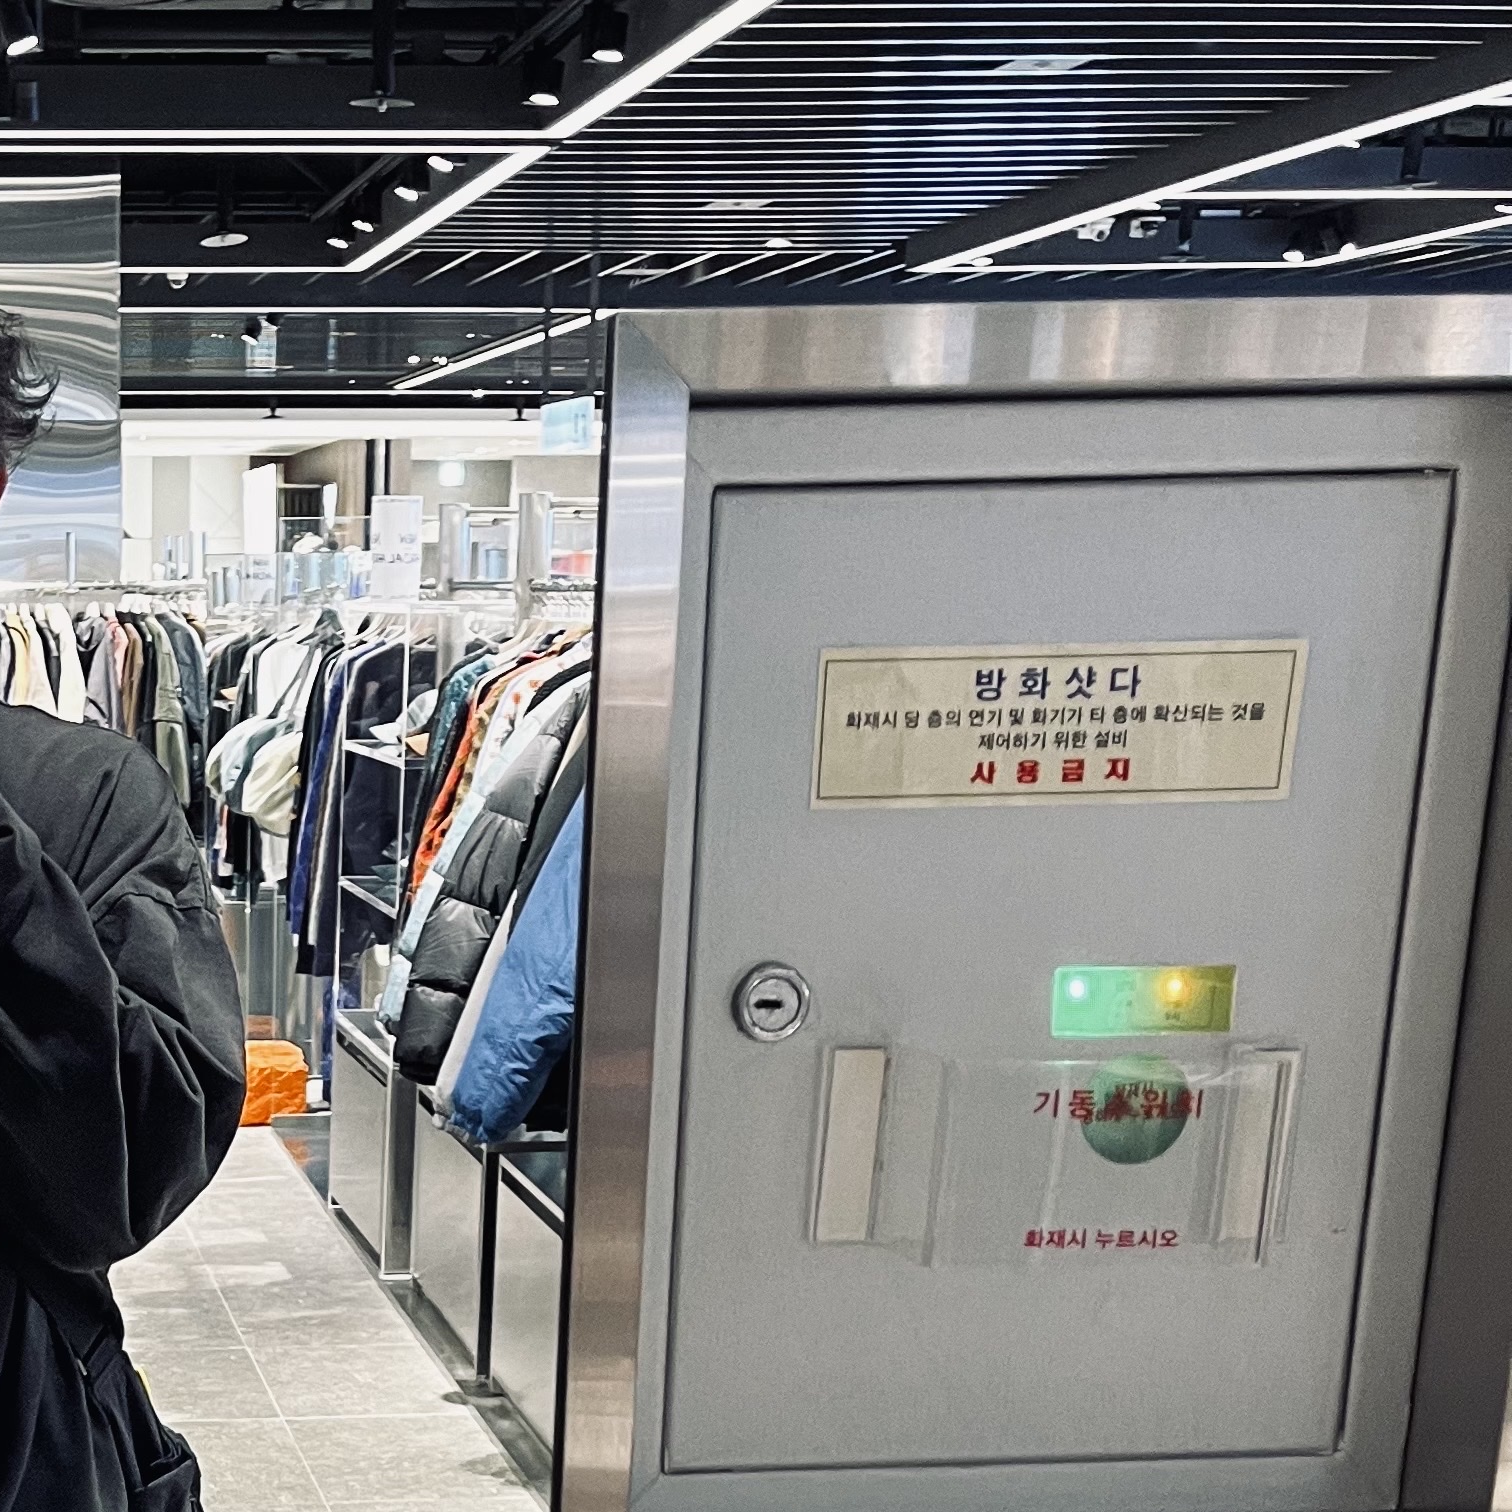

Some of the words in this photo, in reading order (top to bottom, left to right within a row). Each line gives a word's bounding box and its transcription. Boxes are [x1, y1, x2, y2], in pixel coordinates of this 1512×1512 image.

[968, 709, 1002, 728] 연기
[1009, 708, 1024, 728] 및
[1113, 705, 1147, 724] 층에
[1232, 702, 1265, 721] 것을
[978, 731, 1046, 751] 제어하기
[1053, 730, 1087, 751] 위한
[1094, 729, 1127, 749] 설비
[1024, 1228, 1086, 1249] 화재시
[1095, 1229, 1179, 1250] 누르시오
